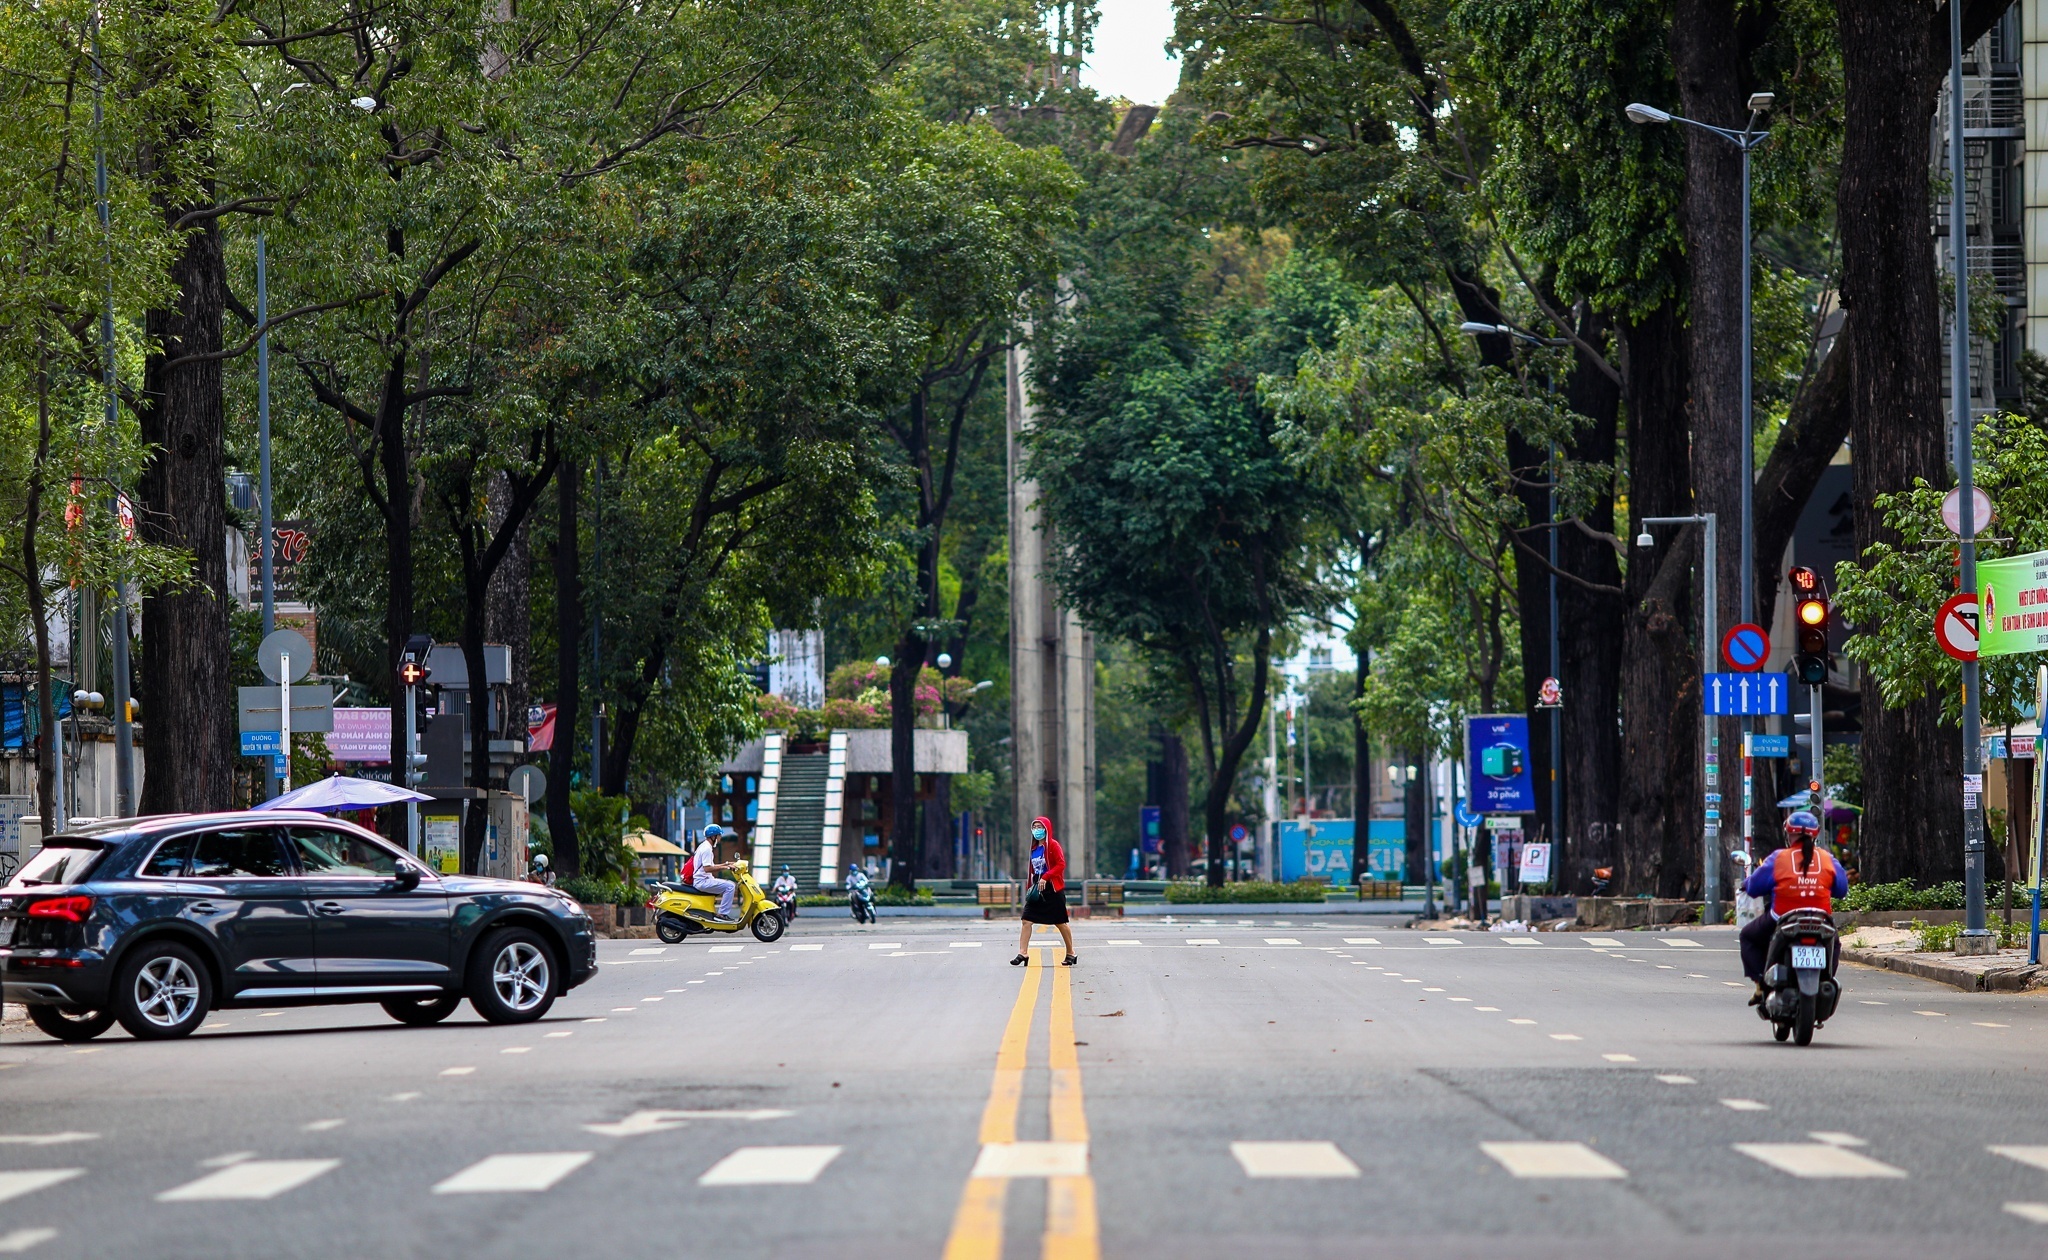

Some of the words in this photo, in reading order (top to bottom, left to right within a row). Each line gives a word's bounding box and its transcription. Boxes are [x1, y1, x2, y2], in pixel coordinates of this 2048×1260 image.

[277, 529, 310, 563] 79
[1796, 571, 1814, 589] 40
[1488, 791, 1499, 799] 30
[1530, 849, 1540, 864] P
[1797, 876, 1818, 885] Now
[1797, 947, 1820, 957] 59-T2
[1795, 957, 1823, 967] 120.14
